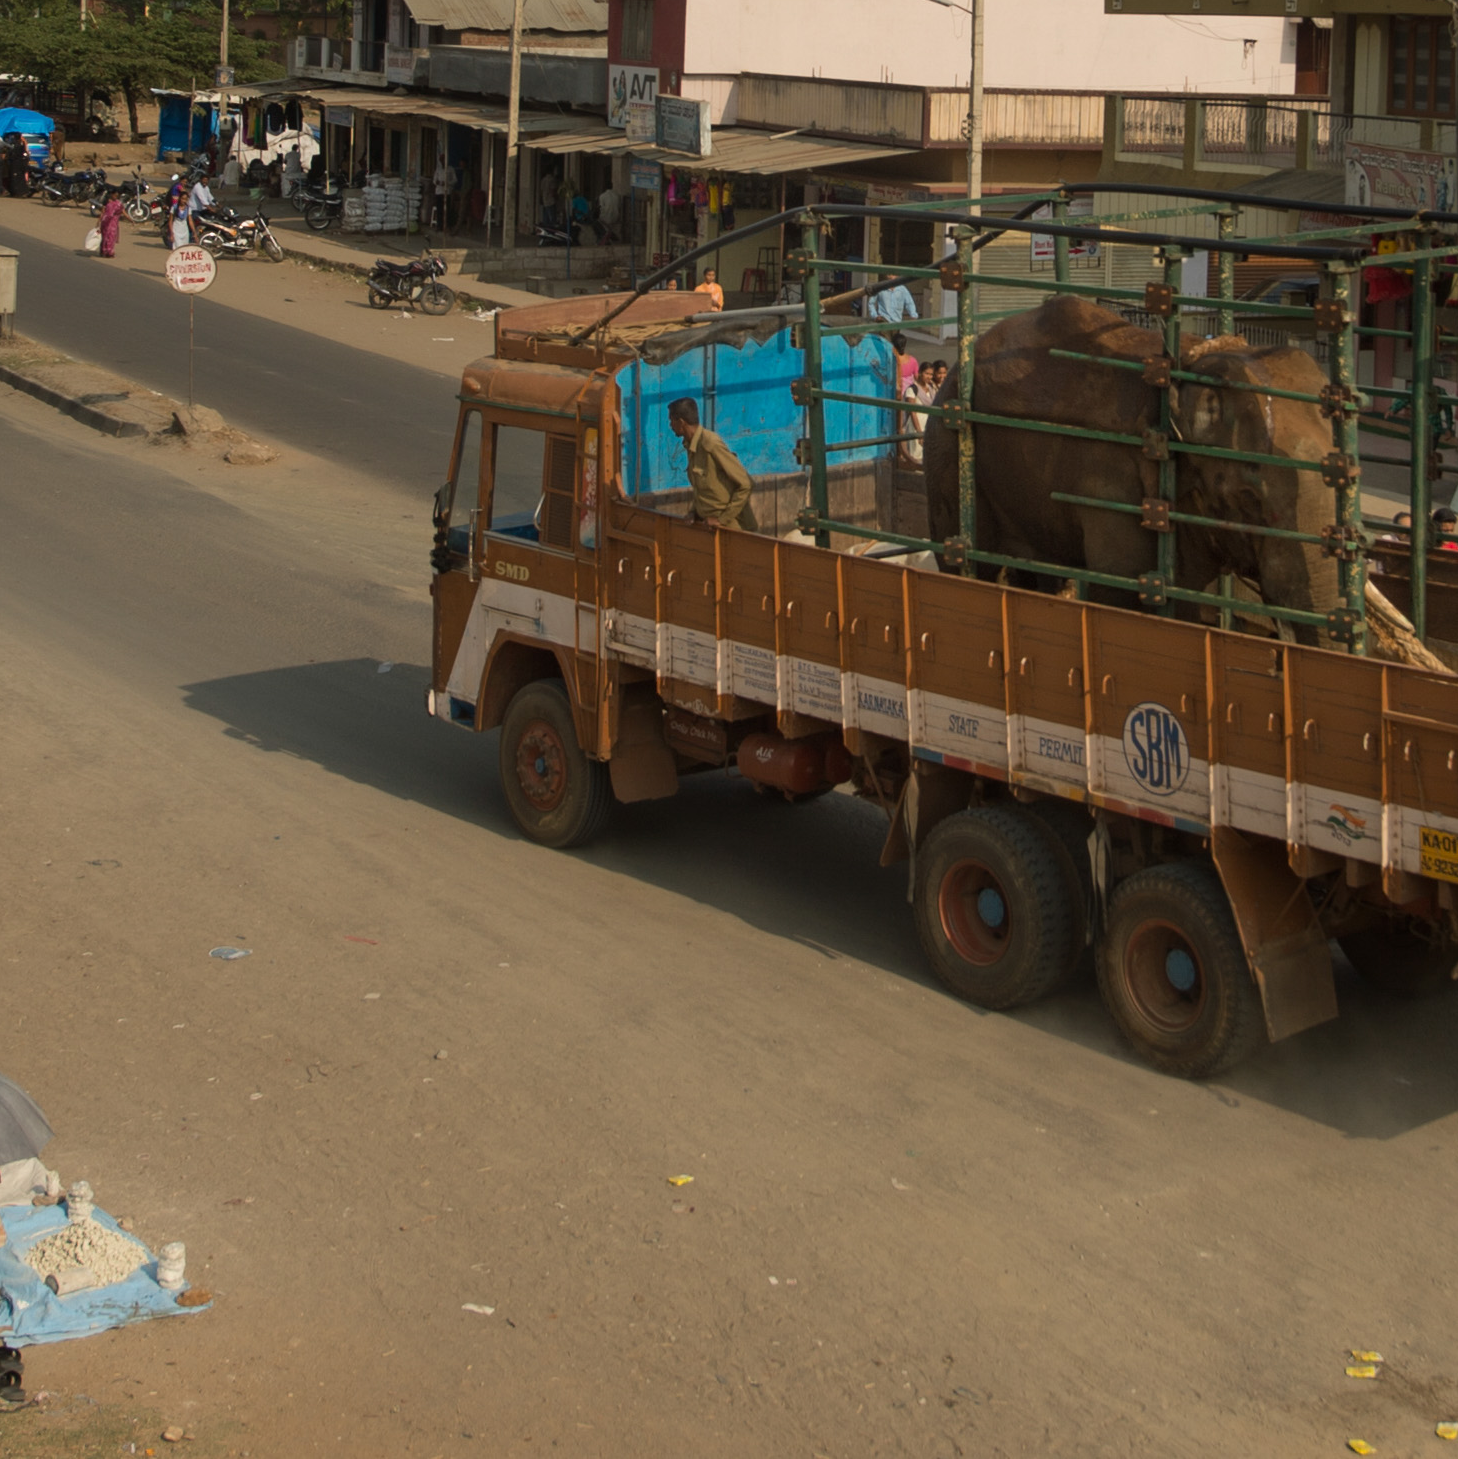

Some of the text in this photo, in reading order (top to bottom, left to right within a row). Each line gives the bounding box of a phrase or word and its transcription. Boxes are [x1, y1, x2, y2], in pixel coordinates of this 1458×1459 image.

[629, 74, 656, 102] AVT
[179, 251, 204, 262] TAKE
[495, 560, 530, 582] SMD
[857, 691, 907, 720] KARNATAKA
[948, 713, 981, 740] STATE
[1038, 736, 1085, 767] PERMIT
[1130, 708, 1182, 790] SBM
